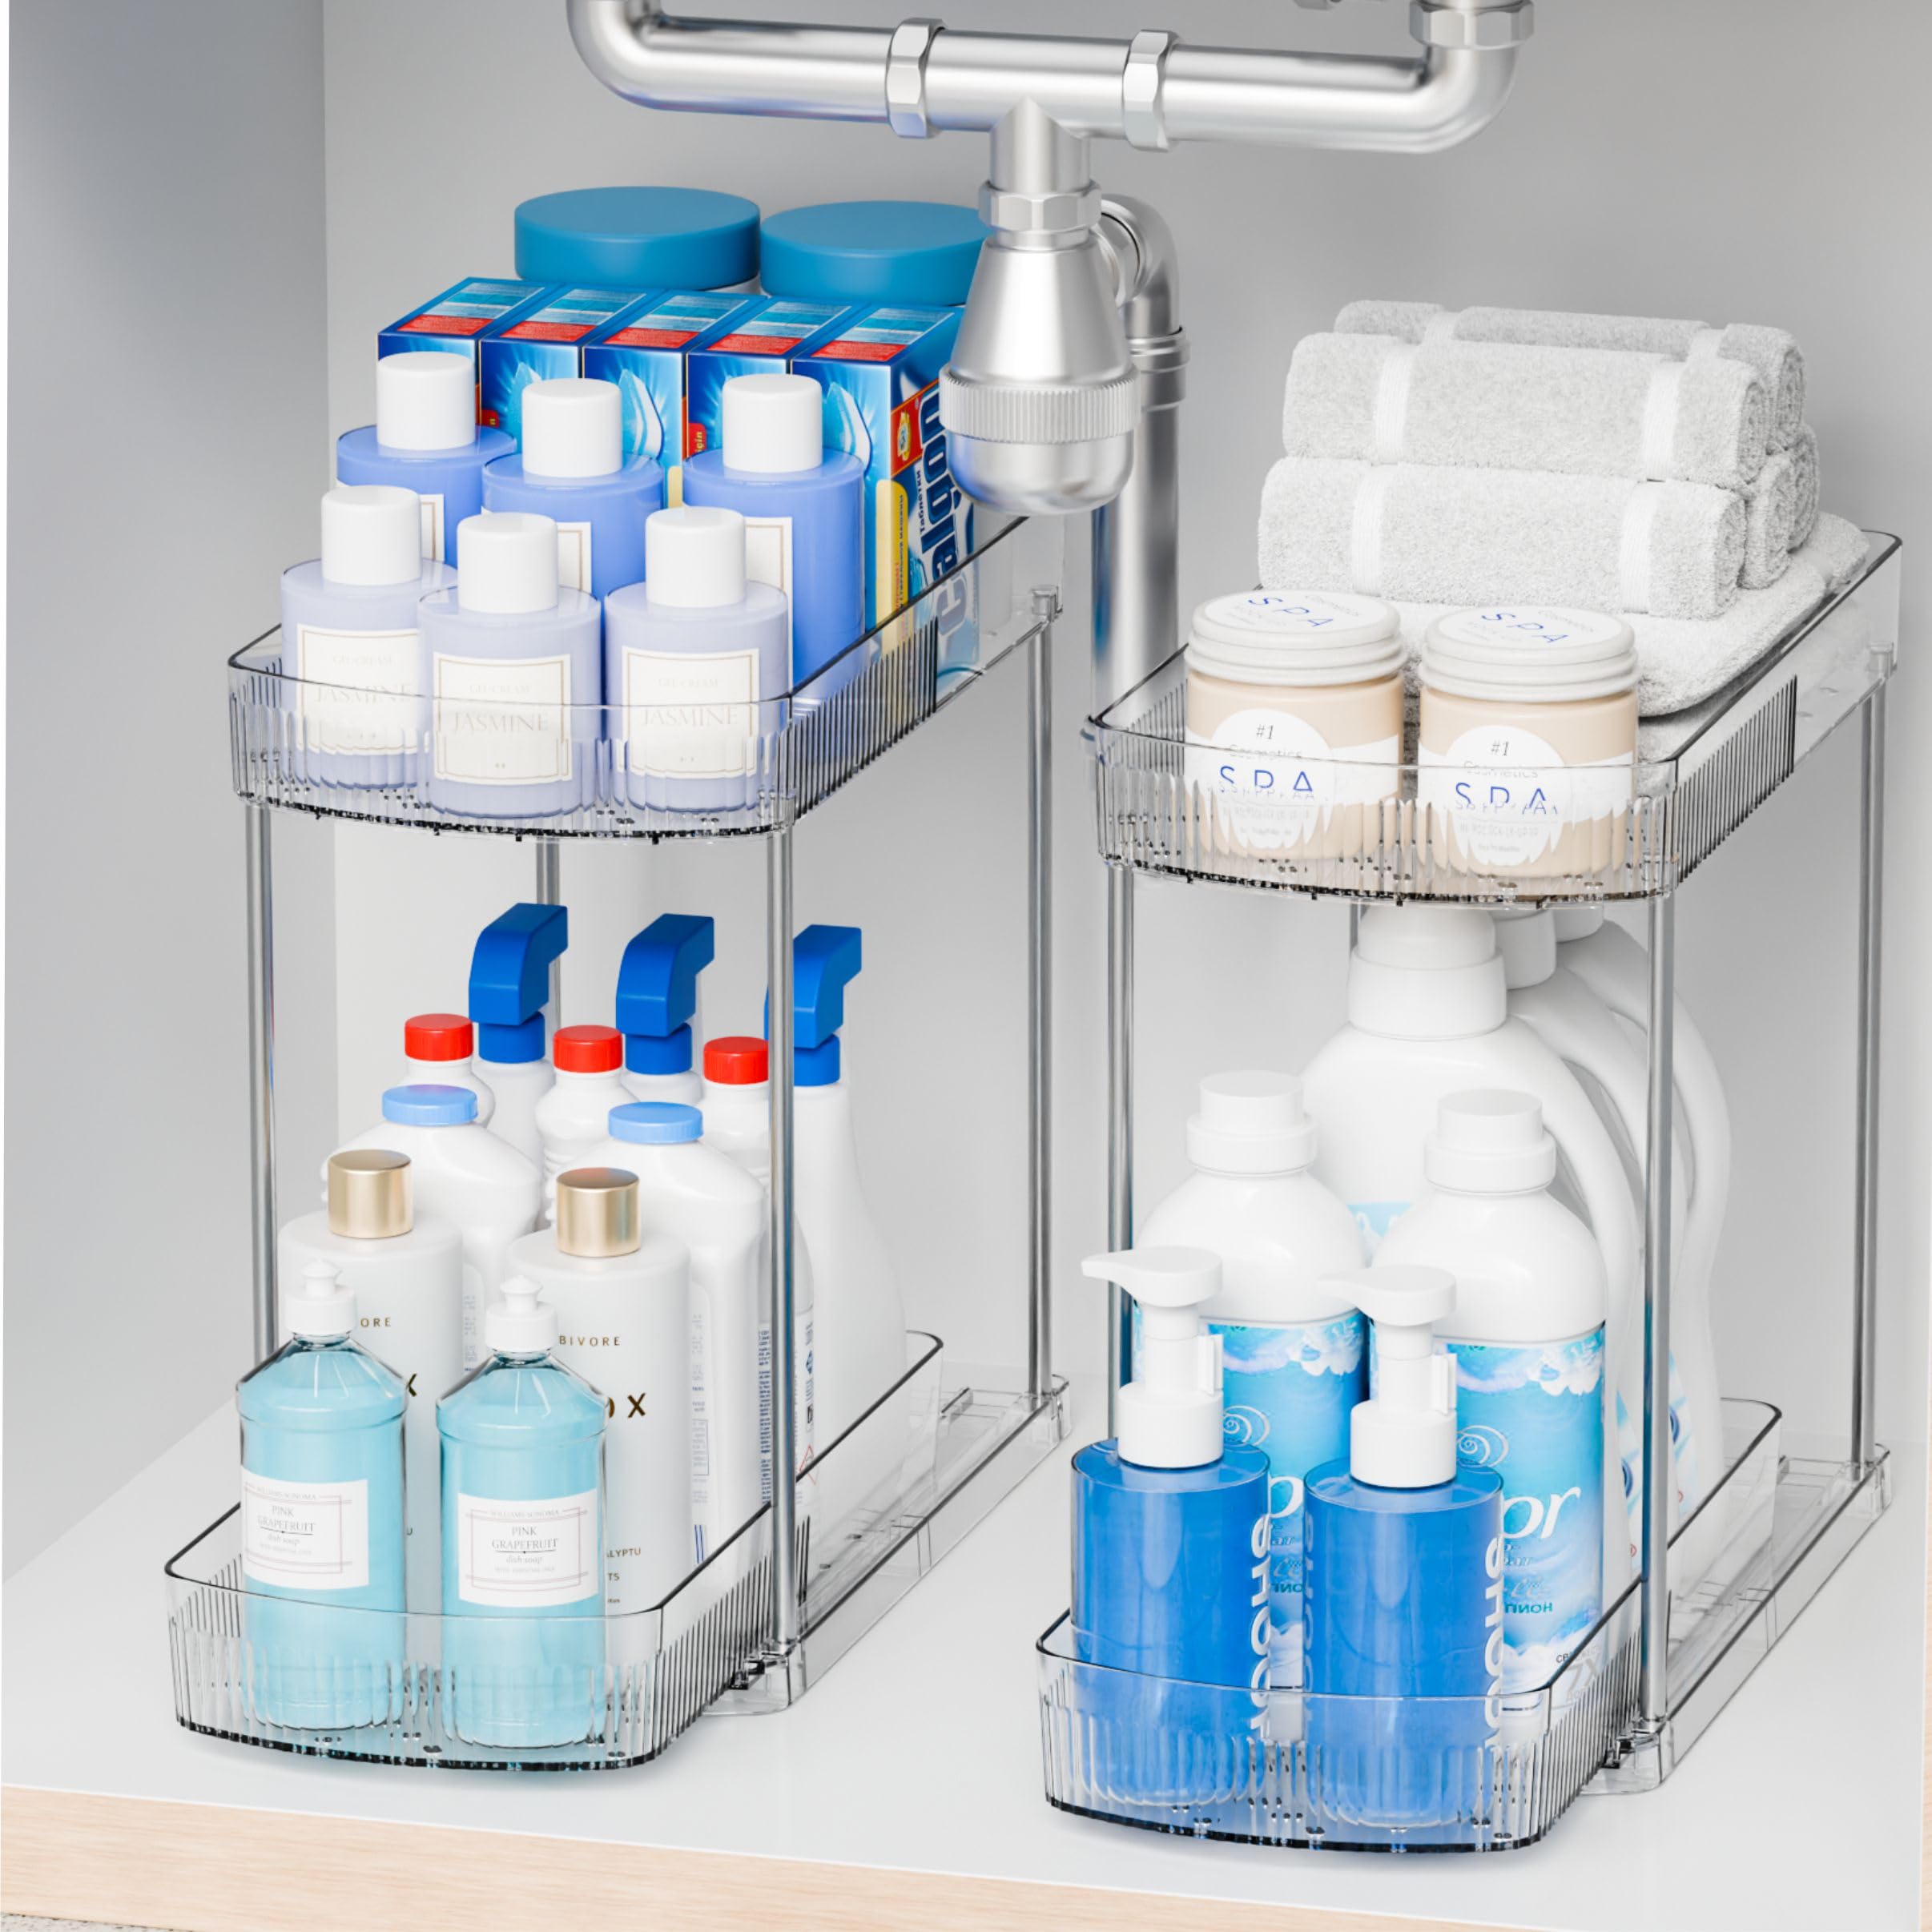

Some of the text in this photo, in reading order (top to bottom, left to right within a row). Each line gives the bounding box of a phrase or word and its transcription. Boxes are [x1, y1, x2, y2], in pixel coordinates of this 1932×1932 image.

[452, 711, 549, 732] JASMINE
[641, 704, 738, 726] JASMINE
[1255, 724, 1274, 739] #1
[1491, 741, 1509, 756] #1
[272, 1505, 294, 1517] PINK
[257, 1515, 316, 1532] GRAPEFRUIT
[511, 1526, 537, 1536] PINK
[491, 1538, 559, 1550] GRAPEFRUIT
